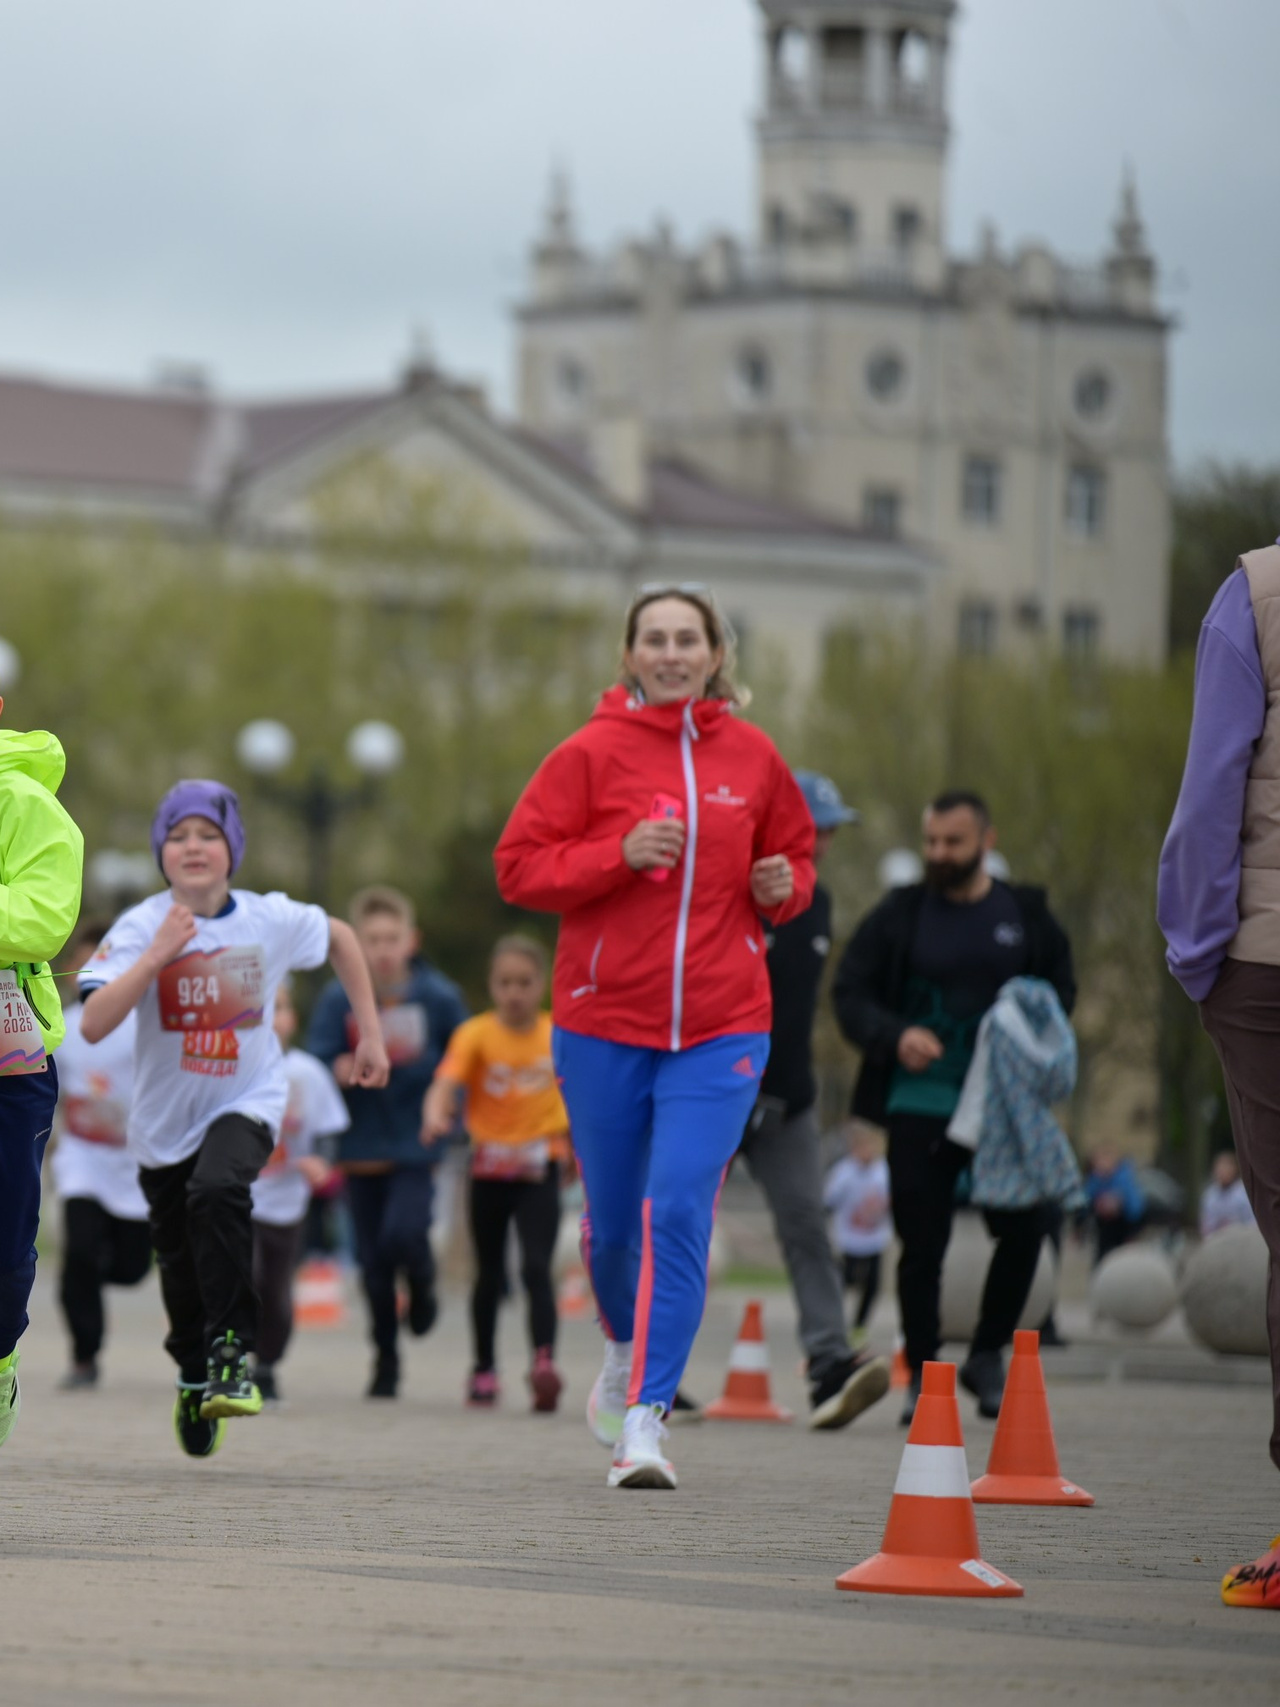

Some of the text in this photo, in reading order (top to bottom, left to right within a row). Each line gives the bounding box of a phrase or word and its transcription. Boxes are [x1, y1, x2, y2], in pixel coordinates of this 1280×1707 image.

[177, 976, 220, 1006] 924
[4, 1002, 12, 1017] 1
[4, 1017, 32, 1033] 2025
